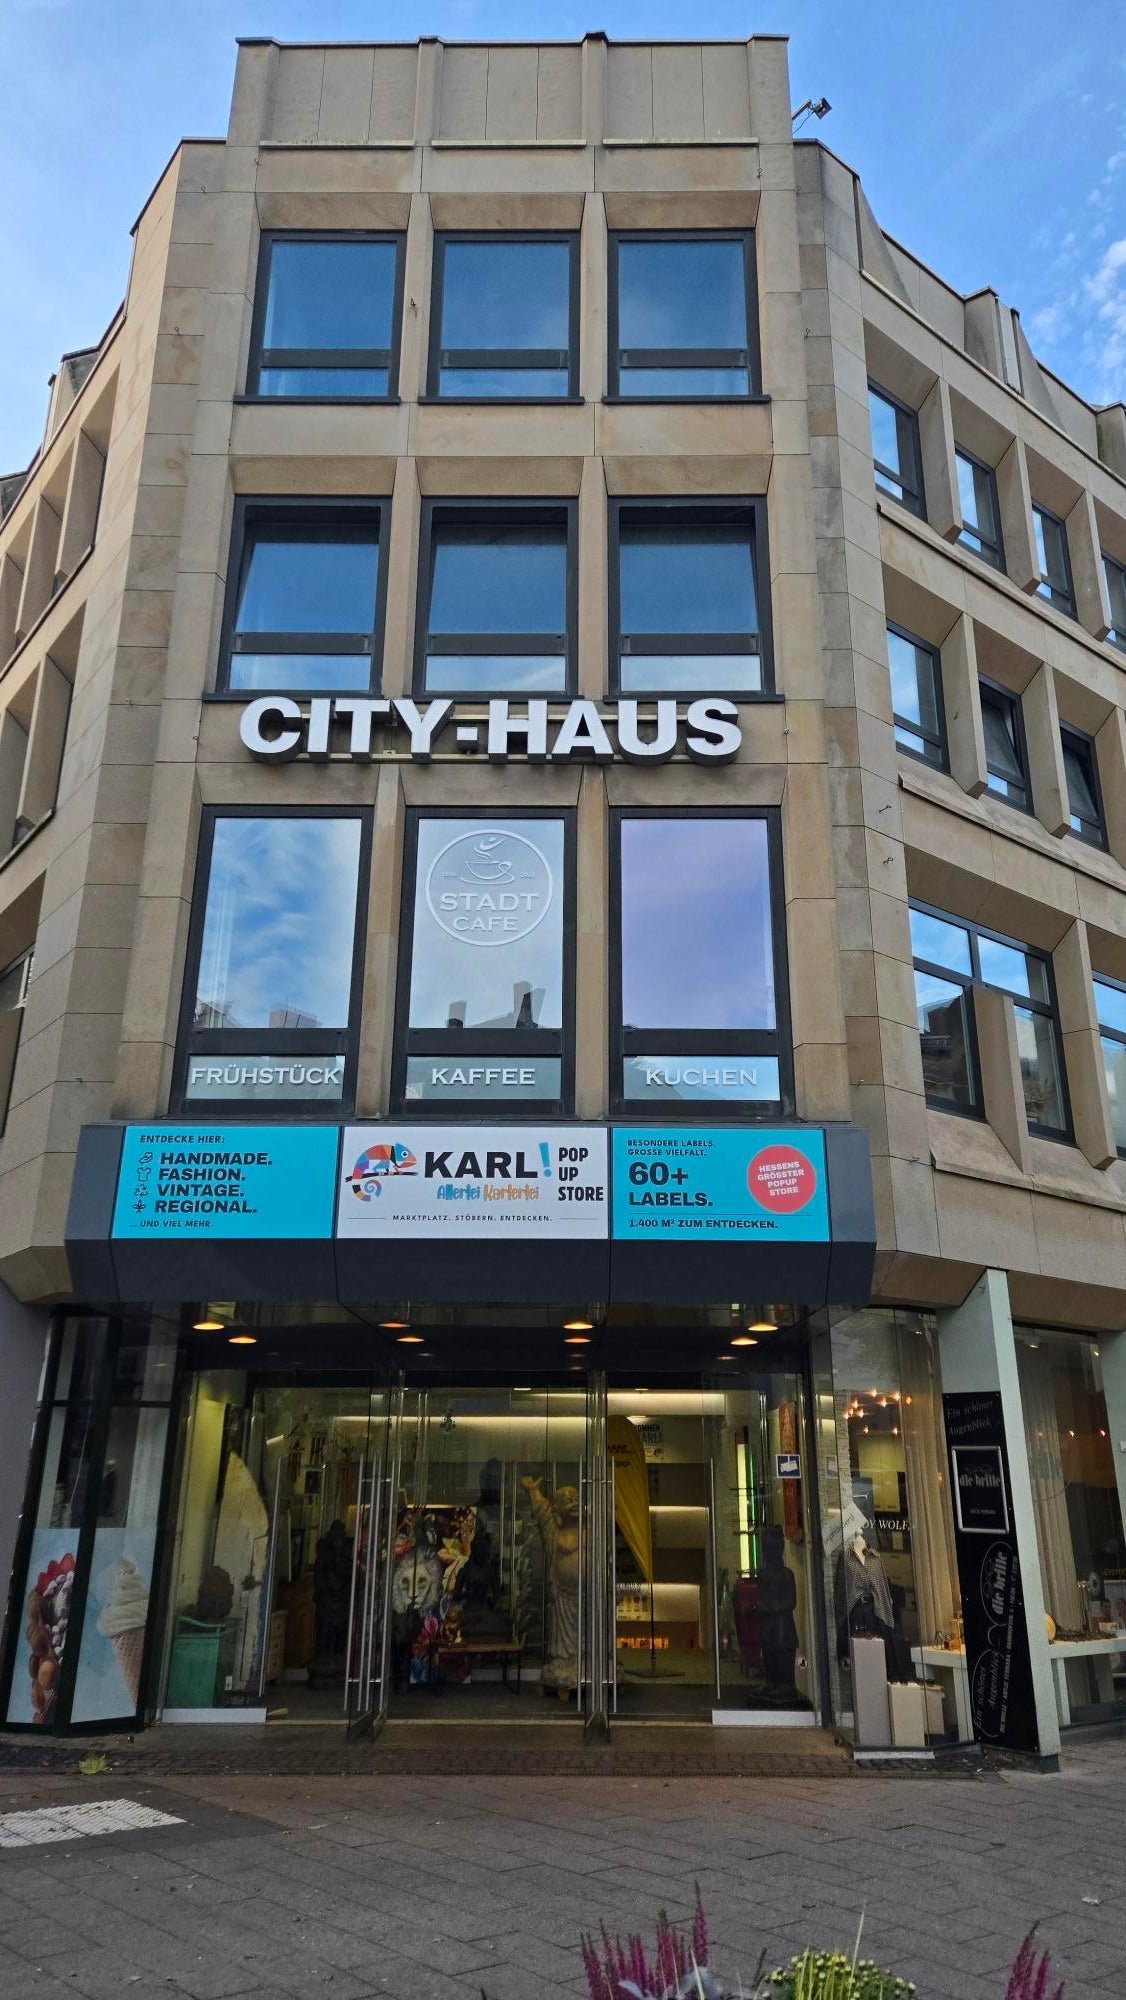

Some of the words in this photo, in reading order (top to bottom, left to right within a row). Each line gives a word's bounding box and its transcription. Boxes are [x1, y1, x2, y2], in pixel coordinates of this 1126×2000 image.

[239, 696, 743, 763] CITY-HAUS
[440, 892, 539, 912] STADT
[453, 916, 518, 932] CAFE
[191, 1064, 342, 1085] FRÜHSTÜCK
[431, 1067, 536, 1086] KAFFEE
[645, 1067, 757, 1087] KUCHEN
[139, 1135, 195, 1144] ENTDECKE
[197, 1135, 226, 1144] HIER:
[627, 1139, 679, 1147] BESONDERE
[681, 1140, 716, 1148] LABELS.
[160, 1152, 273, 1166] HANDMADE.
[558, 1147, 589, 1162] POP
[627, 1148, 663, 1156] GROSSE
[665, 1148, 707, 1157] VIELFALT.
[424, 1142, 553, 1179] KARL!
[758, 1161, 800, 1173] HESSENS
[158, 1168, 246, 1182] FASHION.
[558, 1166, 579, 1182] UP
[629, 1161, 689, 1186] 60+
[767, 1178, 798, 1189] POPUP
[156, 1184, 245, 1198] VINTAGE.
[558, 1186, 604, 1202] STORE
[769, 1186, 799, 1197] STORE
[629, 1191, 714, 1207] LABELS.
[154, 1200, 258, 1214] REGIONAL.
[140, 1220, 160, 1228] UND
[162, 1220, 183, 1228] VIEL
[185, 1220, 214, 1228] MEHR.
[392, 1214, 451, 1222] MARKTPLATZ.
[455, 1213, 497, 1222] STÖBERN.
[500, 1214, 553, 1222] ENTDECKEN.
[629, 1219, 659, 1229] 1.400
[678, 1219, 703, 1229] ZUM
[706, 1219, 779, 1230] ENTDECKEN.
